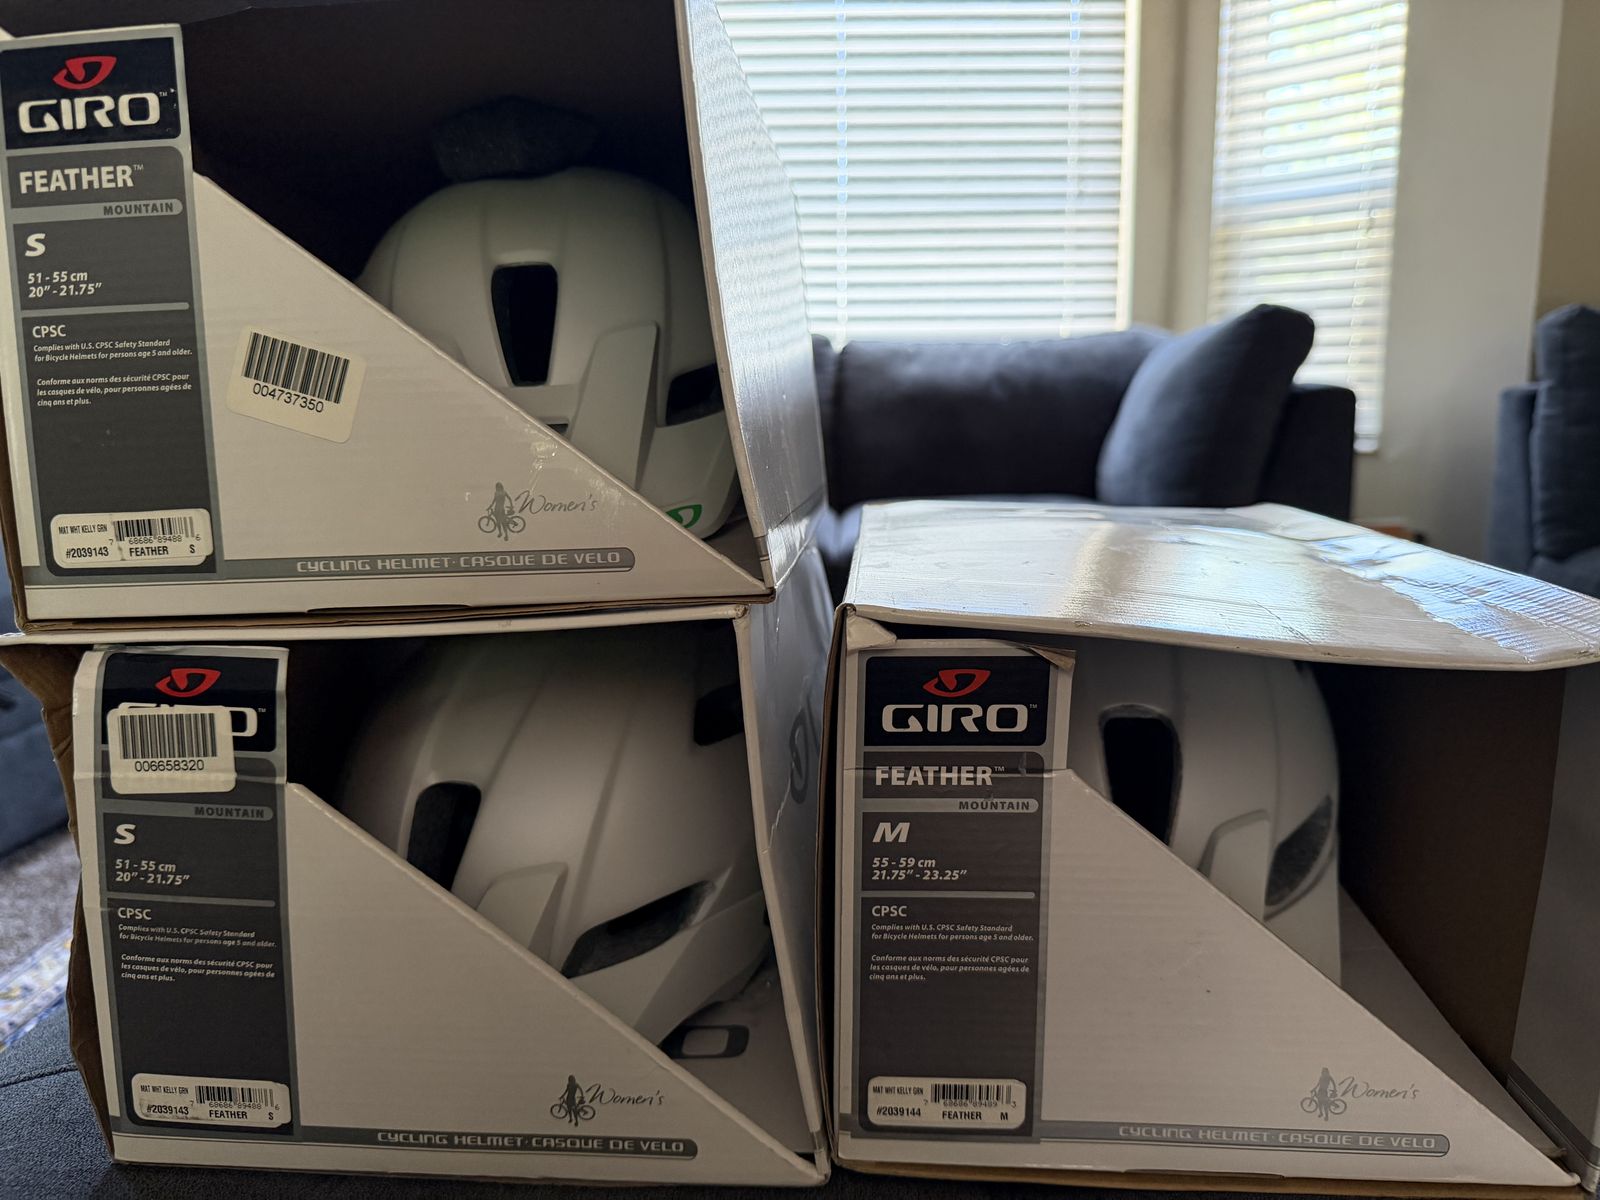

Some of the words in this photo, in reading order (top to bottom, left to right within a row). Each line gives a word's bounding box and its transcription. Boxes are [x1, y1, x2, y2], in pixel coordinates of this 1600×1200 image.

[103, 202, 173, 216] MOUNTAIN
[25, 233, 46, 257] S
[28, 273, 42, 284] 51
[52, 272, 68, 282] 55
[71, 272, 88, 282] cm
[32, 325, 66, 338] CPSC
[33, 344, 63, 353] Complies
[65, 343, 79, 351] with
[81, 342, 94, 350] U.S.
[115, 341, 137, 349] Safety
[138, 339, 170, 348] Standard
[46, 354, 68, 362] Bicycle
[70, 352, 97, 360] Helmets
[172, 348, 192, 356] older.
[37, 378, 71, 386] Conforme
[123, 374, 151, 382] sécurité
[152, 373, 171, 381] CPSC
[172, 374, 189, 382] pour
[37, 388, 46, 396] les
[48, 388, 74, 397] casques
[104, 387, 121, 395] pour
[122, 385, 159, 394] personnes
[160, 384, 181, 392] agées
[37, 399, 52, 408] cinq
[75, 398, 91, 406] plus.
[253, 383, 324, 412] 004737350
[515, 490, 598, 514] Women's
[59, 526, 68, 534] MAT
[82, 525, 96, 533] KELLY
[98, 524, 107, 532] GRN
[66, 547, 109, 558] #2039143
[129, 546, 168, 557] FEATHER
[190, 544, 195, 553] S
[297, 560, 370, 572] CYCLING
[542, 553, 567, 565] DE
[574, 552, 620, 564] VELO
[135, 759, 204, 772] 006658320
[959, 801, 1029, 810] MOUNTAIN
[194, 807, 264, 818] MOUNTAIN
[113, 824, 136, 844] S
[872, 822, 910, 843] M
[115, 859, 131, 869] 51
[140, 861, 156, 871] 55
[158, 863, 176, 872] cm
[872, 858, 889, 868] 55
[899, 858, 915, 868] 59
[918, 859, 935, 868] cm
[118, 907, 151, 919] CPSC
[872, 905, 907, 917] CPSC
[871, 923, 903, 932] Complies
[872, 933, 882, 941] for
[883, 933, 907, 941] Bicycle
[938, 933, 948, 941] for
[871, 954, 907, 962] Conforme
[961, 955, 989, 963] sécurité
[881, 965, 910, 973] casques
[941, 965, 958, 973] pour
[121, 971, 136, 980] cinq
[158, 974, 175, 982] plus.
[869, 973, 884, 981] cinq
[152, 1085, 162, 1093] WHT
[163, 1086, 177, 1094] KELLY
[885, 1086, 895, 1094] WHT
[913, 1087, 923, 1095] GRN
[1338, 1076, 1419, 1099] Women's
[586, 1084, 664, 1106] Women's
[147, 1105, 189, 1115] #2039143
[209, 1110, 247, 1119] FEATHER
[268, 1112, 274, 1120] S
[877, 1106, 921, 1117] #2039144
[942, 1111, 982, 1120] FEATHER
[1001, 1112, 1008, 1120] M
[377, 1132, 448, 1144] CYCLING
[609, 1139, 634, 1150] DE
[640, 1140, 683, 1152] VELO
[1119, 1125, 1192, 1138] CYCLING
[1359, 1135, 1383, 1146] DE
[1390, 1136, 1435, 1148] VELO
